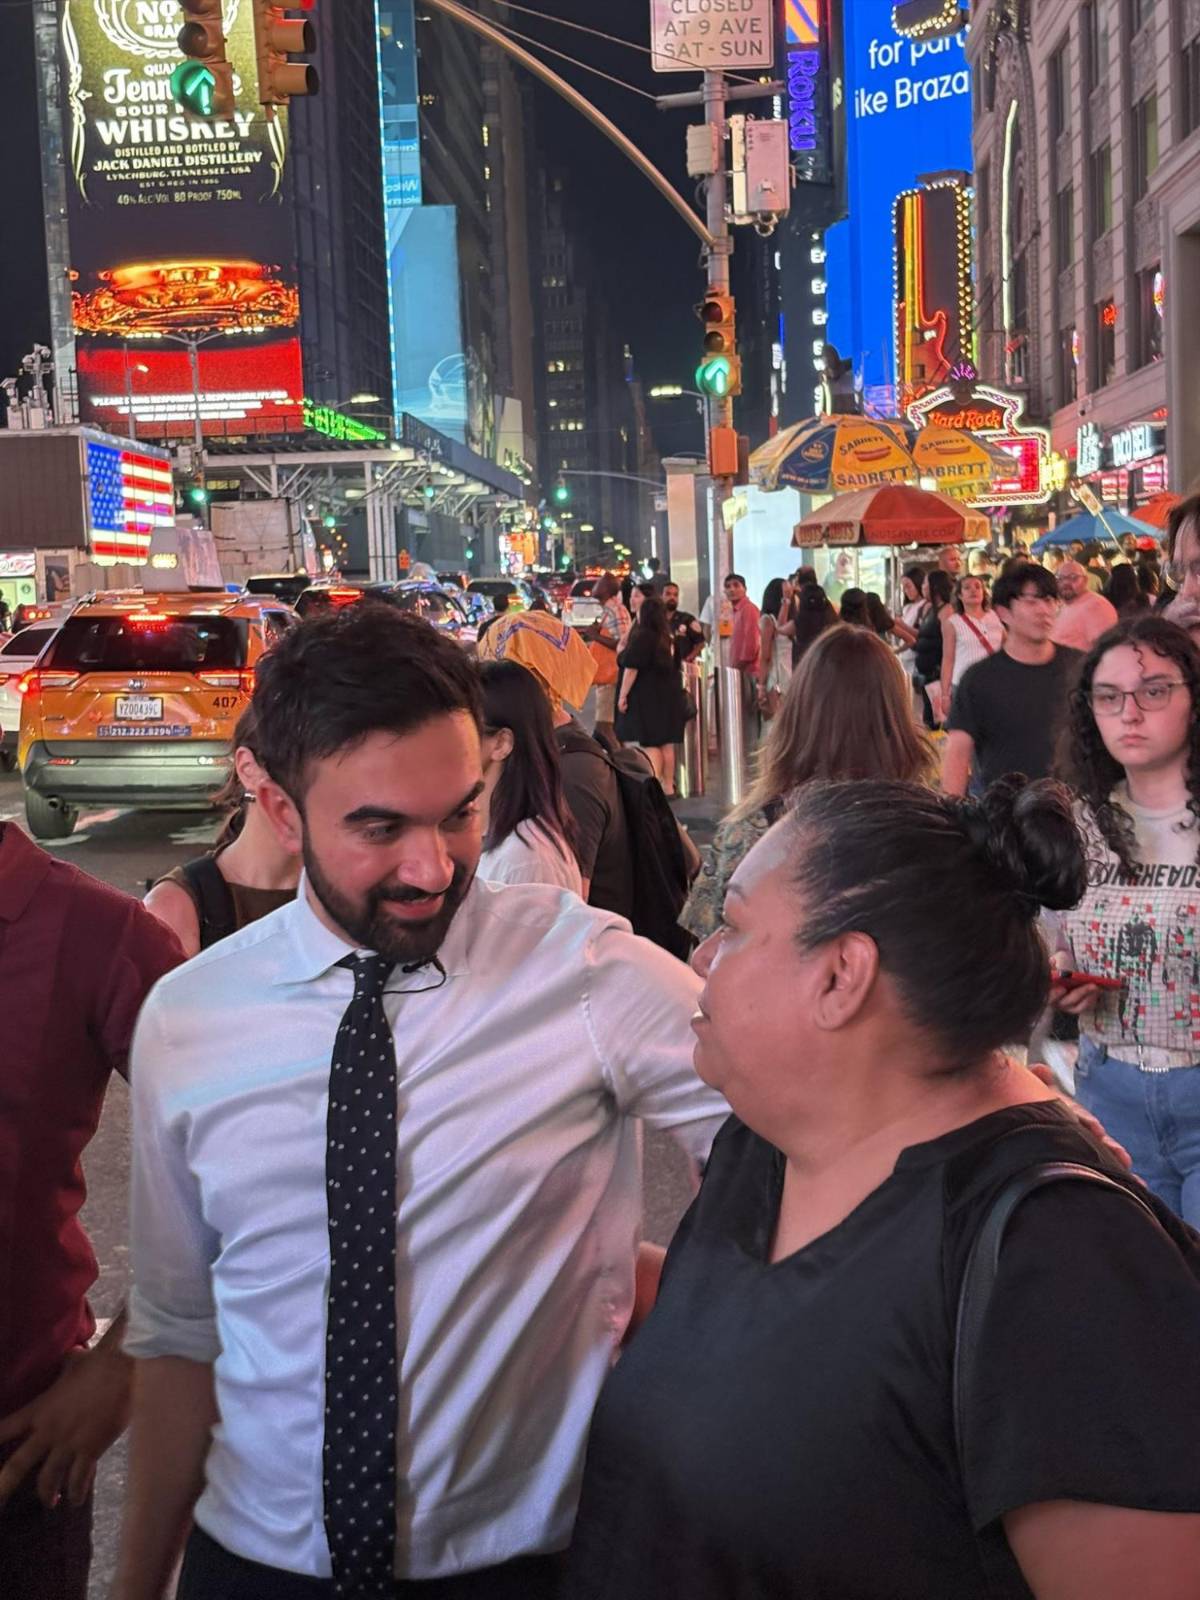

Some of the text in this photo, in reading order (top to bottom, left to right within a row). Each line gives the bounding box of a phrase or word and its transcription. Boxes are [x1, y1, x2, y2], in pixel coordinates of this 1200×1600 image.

[671, 0, 754, 14] CLOSED
[663, 18, 763, 36] AT 9 AVE
[663, 41, 704, 59] SAT
[720, 40, 764, 57] SUN
[868, 38, 904, 70] for
[786, 50, 820, 151] ROKU
[854, 87, 889, 119] ike
[895, 70, 969, 109] Braza
[115, 103, 168, 117] SOUR
[95, 112, 255, 145] WHISKEY
[114, 141, 241, 158] DISTILLED AND BOTTLED BY
[93, 152, 263, 171] JACK DANIEL DISTILLERY
[231, 165, 252, 174] USA
[174, 191, 187, 203] 80
[928, 409, 1001, 431] Hard Rock
[836, 465, 910, 487] SABRETT
[212, 696, 238, 708] 407
